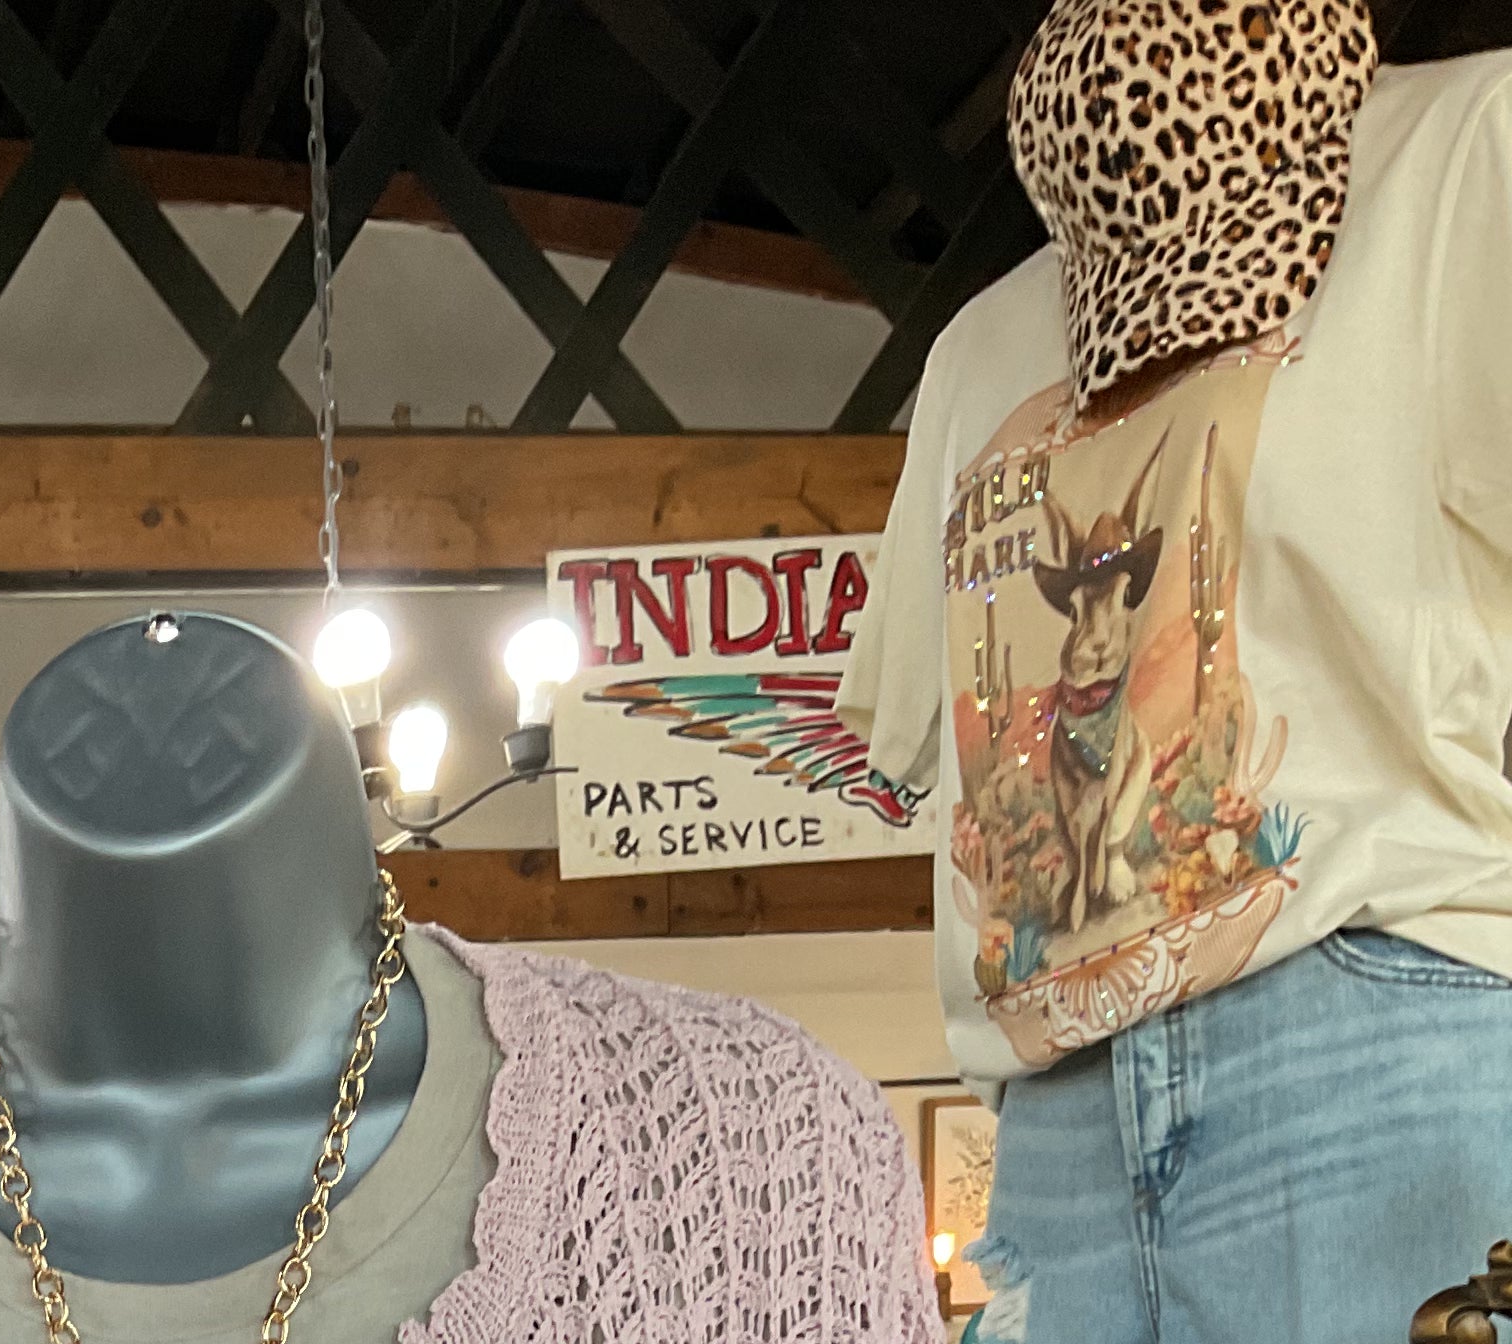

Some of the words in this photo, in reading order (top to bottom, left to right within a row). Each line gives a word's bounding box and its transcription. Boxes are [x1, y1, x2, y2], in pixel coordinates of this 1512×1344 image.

[944, 527, 1037, 594] HARE
[558, 547, 870, 666] INDIA
[583, 776, 720, 818] PARTS
[614, 826, 640, 859] &
[657, 817, 825, 857] SERVICE
